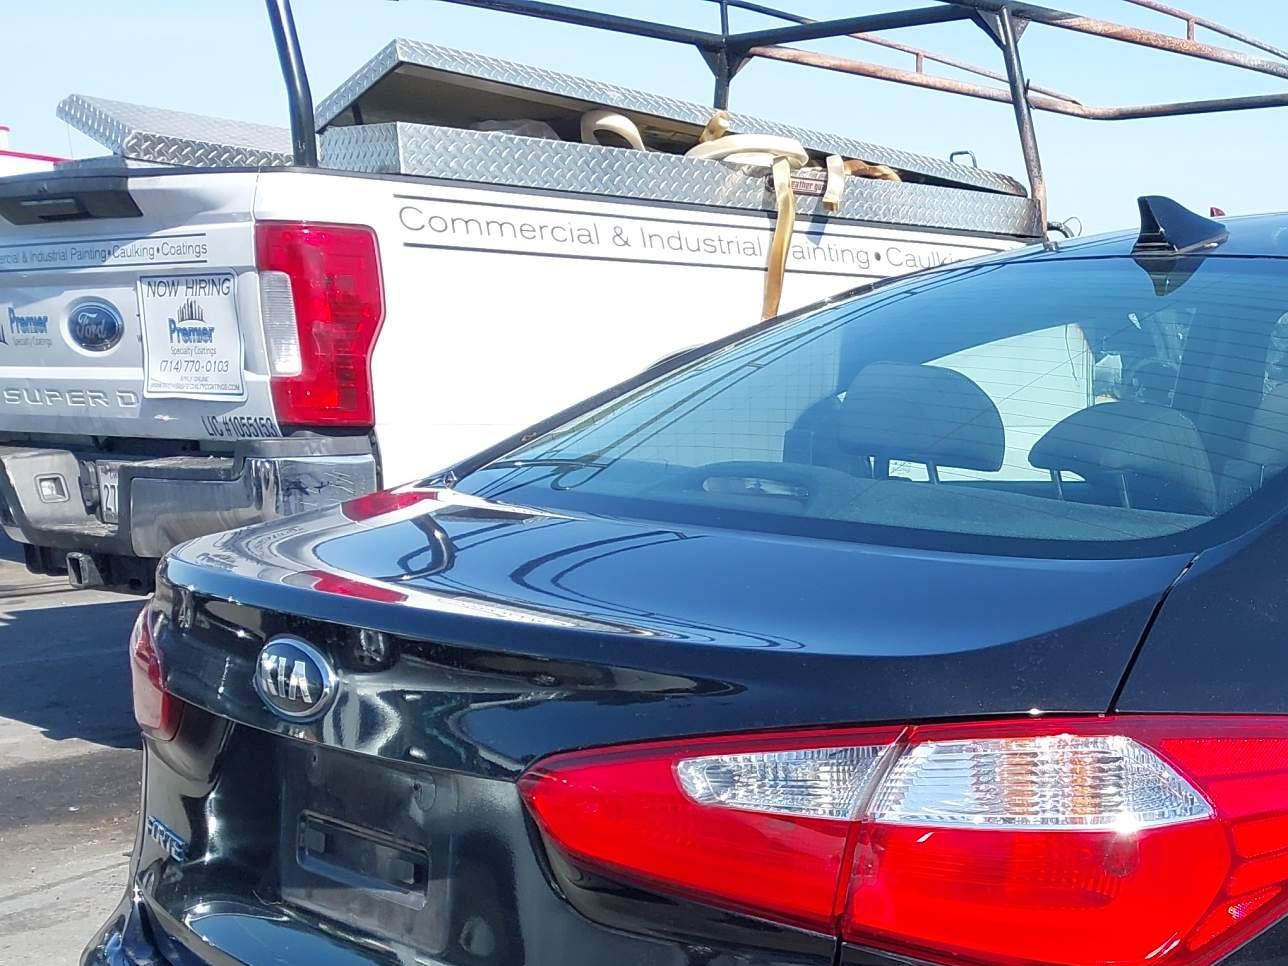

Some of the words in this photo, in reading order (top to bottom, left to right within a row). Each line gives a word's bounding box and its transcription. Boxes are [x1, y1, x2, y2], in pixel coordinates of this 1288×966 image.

[398, 205, 601, 245] Commercial
[611, 225, 632, 247] &
[640, 226, 763, 257] Industrial
[791, 242, 871, 269] ainting
[70, 246, 107, 263] Painting
[111, 243, 155, 259] Caulking
[160, 241, 208, 257] Coatings
[146, 280, 180, 298] NOW
[185, 277, 231, 297] HIRING
[76, 311, 108, 339] Ford
[168, 317, 215, 344] Premier
[159, 360, 182, 373] (714)
[184, 359, 230, 373] 770-0103
[3, 388, 109, 407] SUPER
[260, 652, 313, 703] KIA
